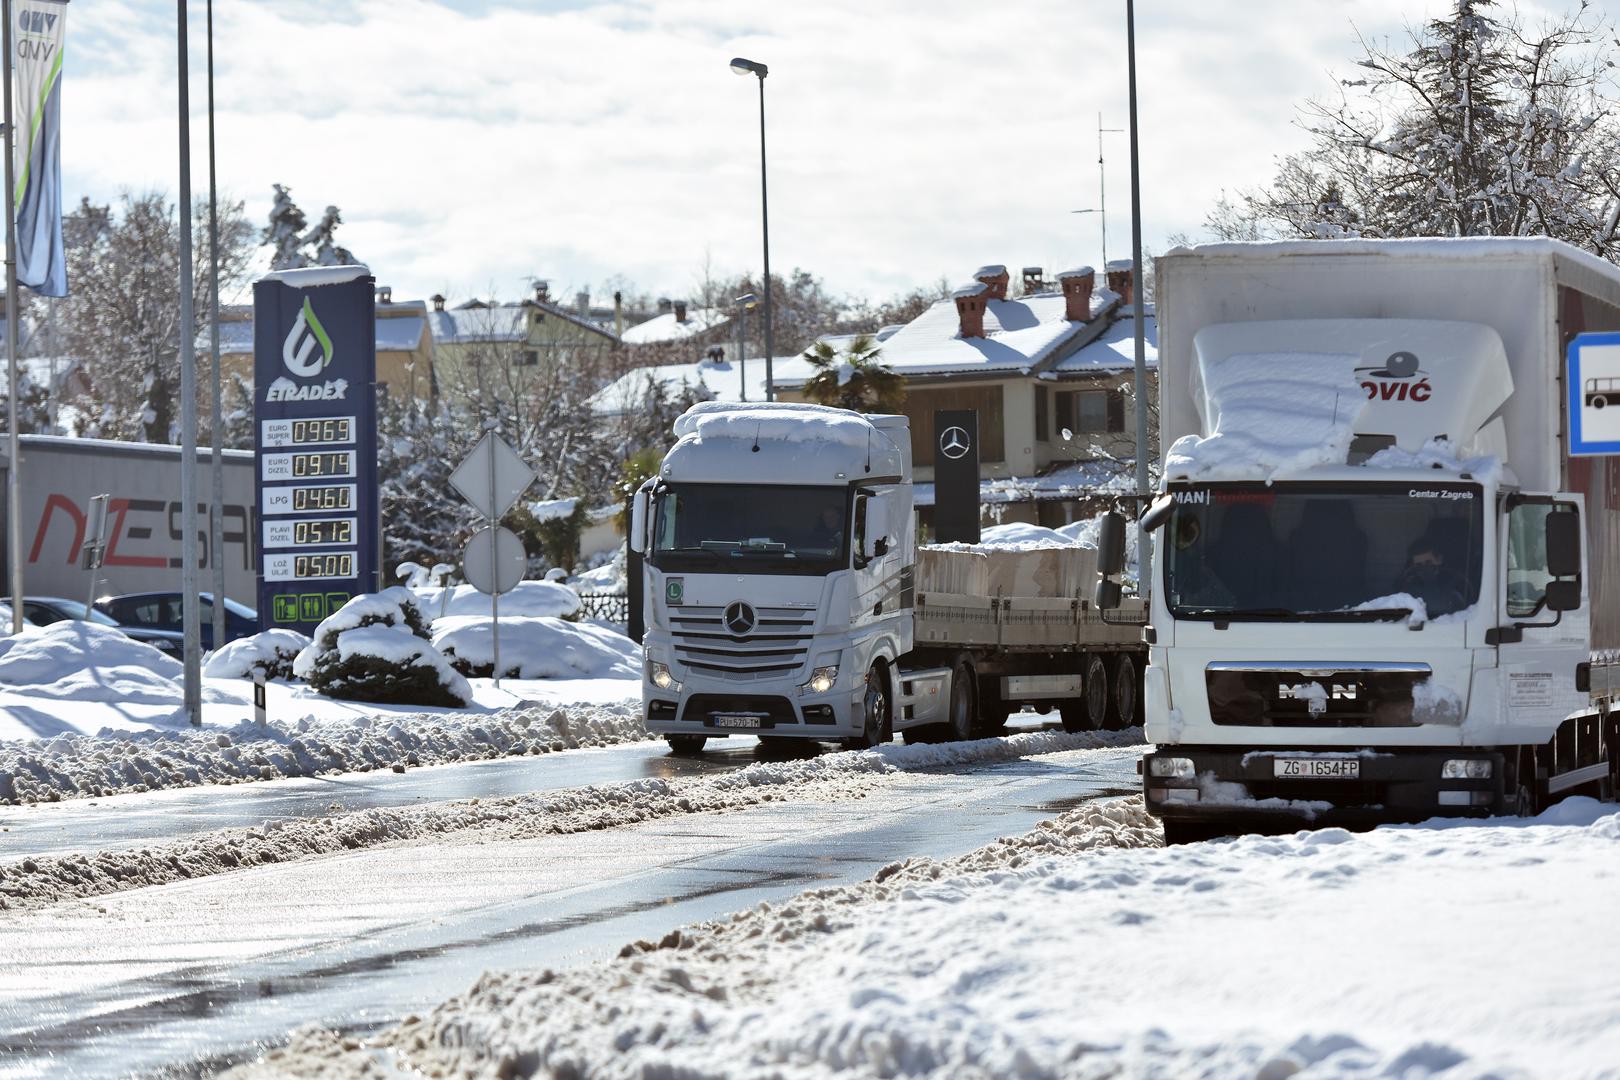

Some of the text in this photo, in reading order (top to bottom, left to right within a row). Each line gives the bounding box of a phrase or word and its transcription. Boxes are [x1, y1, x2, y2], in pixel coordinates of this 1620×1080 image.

[265, 378, 348, 402] ETRADEX
[269, 496, 288, 505] LPG
[1172, 491, 1204, 504] MAN
[1409, 489, 1473, 500] Centar Zagreb
[670, 585, 677, 596] L
[1279, 684, 1356, 699] MN
[1284, 761, 1300, 775] ZG
